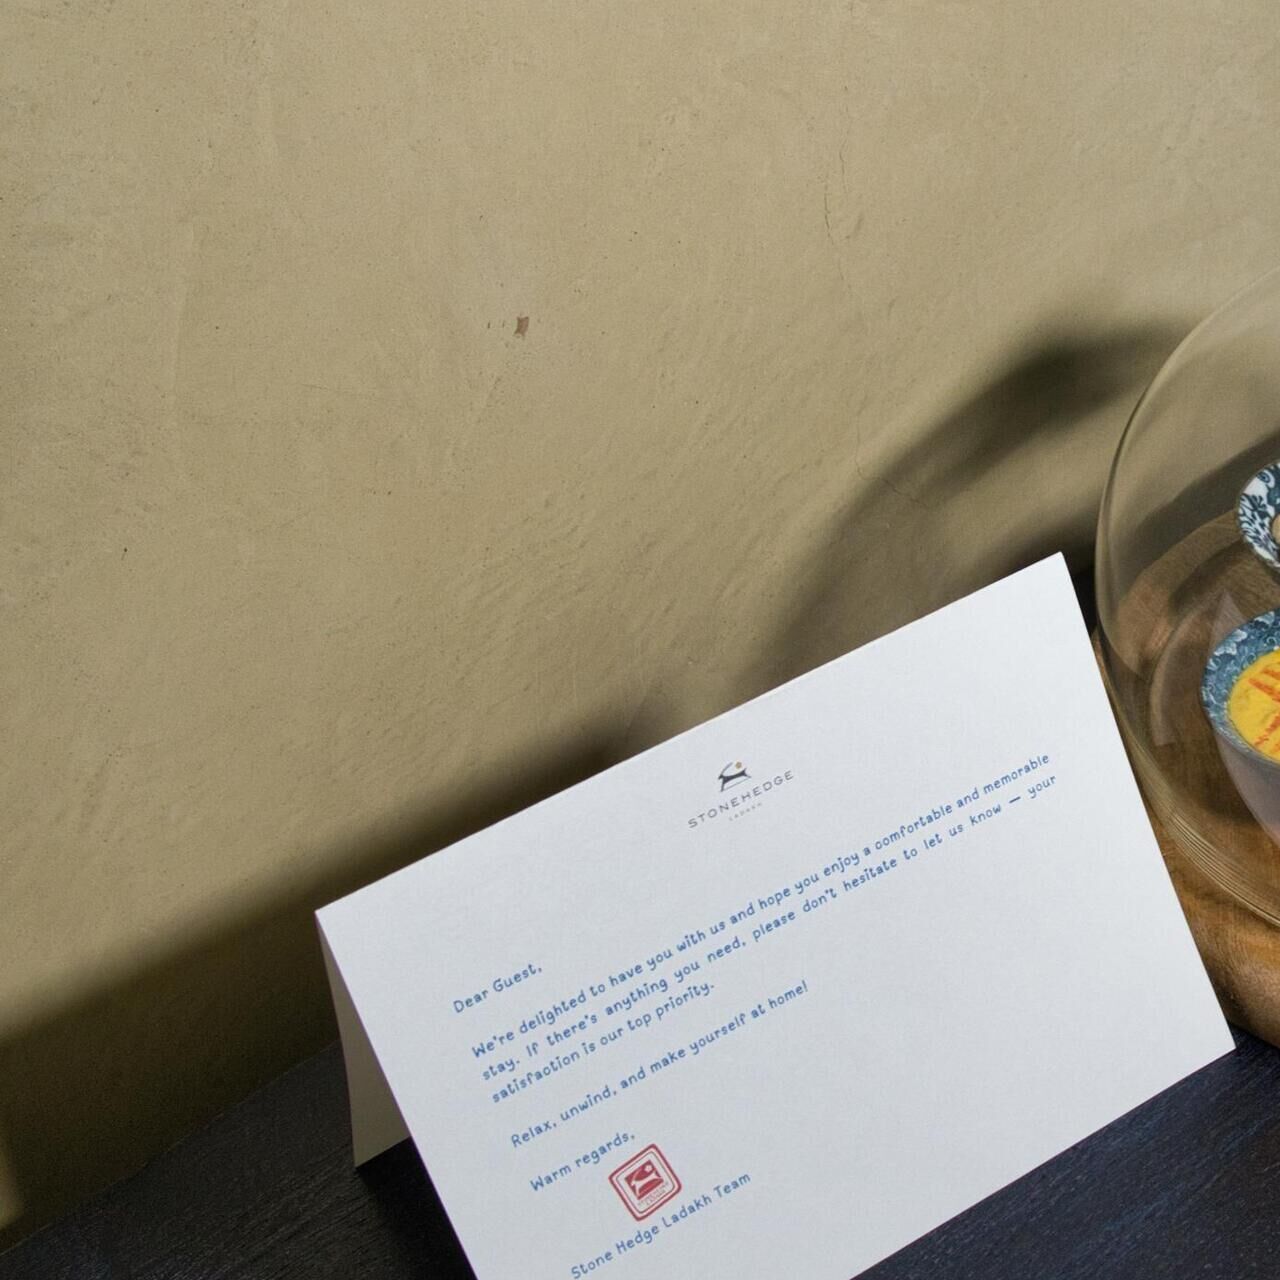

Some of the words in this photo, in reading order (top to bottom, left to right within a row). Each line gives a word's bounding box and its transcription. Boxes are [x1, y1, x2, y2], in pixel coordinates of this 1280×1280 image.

[687, 770, 794, 829] STONEHEDGE
[471, 1031, 515, 1058] We're
[519, 989, 587, 1034] delighted
[589, 983, 606, 997] to
[608, 964, 644, 987] have
[646, 949, 674, 972] you
[676, 929, 707, 952] with
[709, 921, 726, 935] us
[729, 901, 756, 925] and
[757, 887, 792, 910] hope
[794, 873, 820, 895] you
[823, 852, 860, 877] enjoy
[862, 846, 872, 857] a
[874, 804, 953, 850] comfortable
[956, 786, 980, 808] and
[982, 755, 1050, 795] memorable
[482, 1058, 521, 1081] stay.
[525, 1042, 539, 1057] If
[546, 1014, 598, 1046] there's
[605, 978, 669, 1016] anything
[673, 961, 701, 984] you
[706, 935, 747, 963] need,
[752, 911, 796, 943] please
[802, 887, 838, 913] don't
[842, 858, 898, 892] hesitate
[902, 848, 918, 861] to
[922, 833, 943, 850] let
[948, 824, 964, 837] us
[969, 804, 1002, 827] know
[1027, 775, 1056, 800] your
[452, 989, 489, 1014] Dear
[492, 963, 543, 993] Guest,
[492, 1051, 581, 1104] satisfaction
[581, 1042, 597, 1055] is
[599, 1027, 624, 1046] our
[626, 1013, 652, 1031] top
[655, 983, 715, 1021] priority.
[510, 1120, 557, 1148] Relax,
[559, 1084, 617, 1122] unwind,
[619, 1065, 647, 1090] and
[649, 1048, 686, 1073] make
[688, 1012, 746, 1056] yourself
[750, 1003, 766, 1019] at
[767, 979, 809, 1009] home!
[529, 1164, 572, 1192] Warm
[574, 1132, 636, 1168] regards,
[570, 1251, 614, 1280] Stone
[615, 1225, 660, 1255] Hedge
[661, 1194, 713, 1228] Ladakh
[713, 1173, 751, 1198] Team
